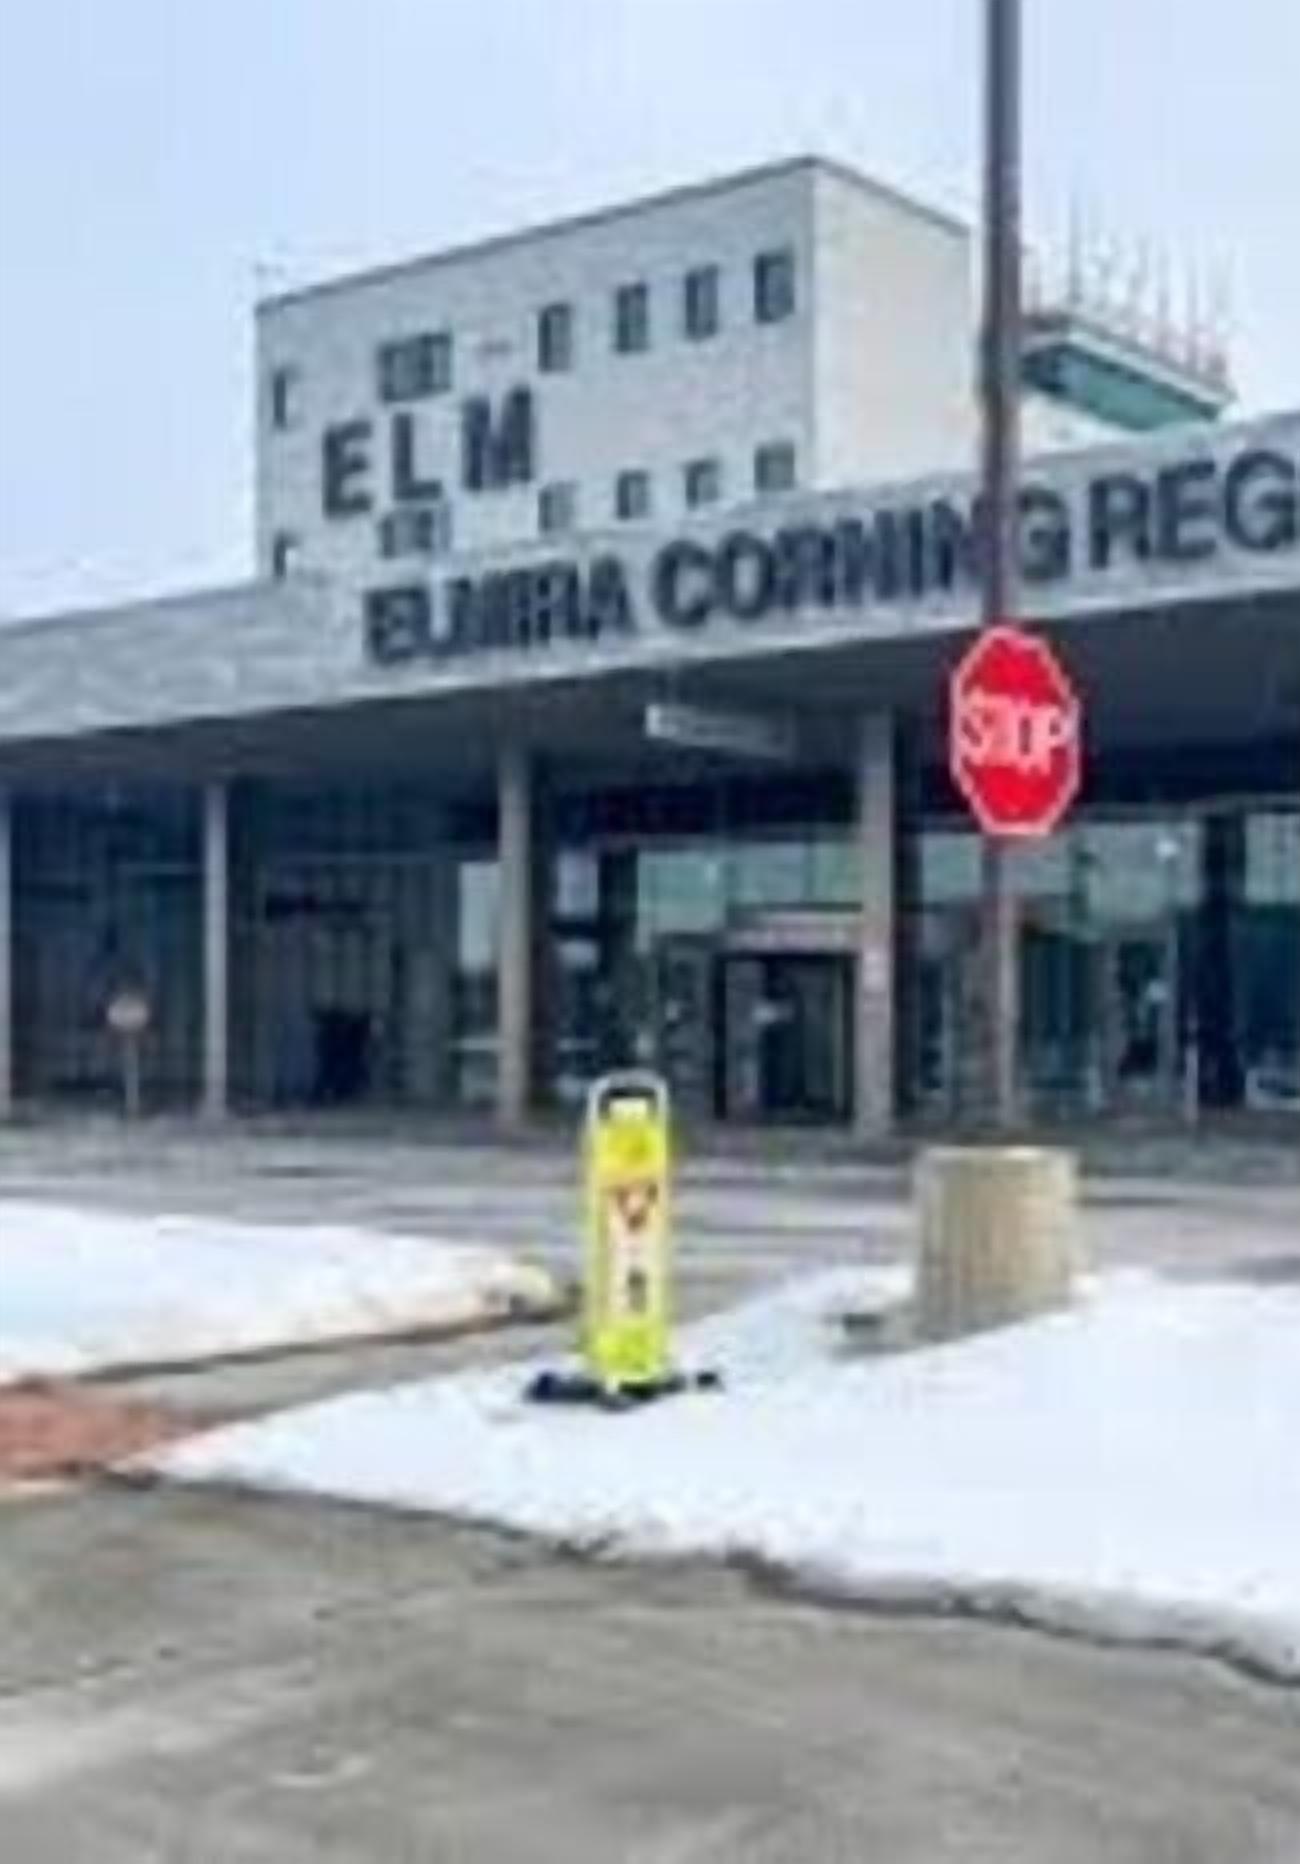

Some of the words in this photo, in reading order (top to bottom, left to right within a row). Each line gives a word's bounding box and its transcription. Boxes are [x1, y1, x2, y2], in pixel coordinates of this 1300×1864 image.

[322, 385, 538, 520] ELM
[363, 558, 637, 666] ELMIRA
[651, 487, 1069, 627] CORNING
[957, 690, 1074, 774] STOP
